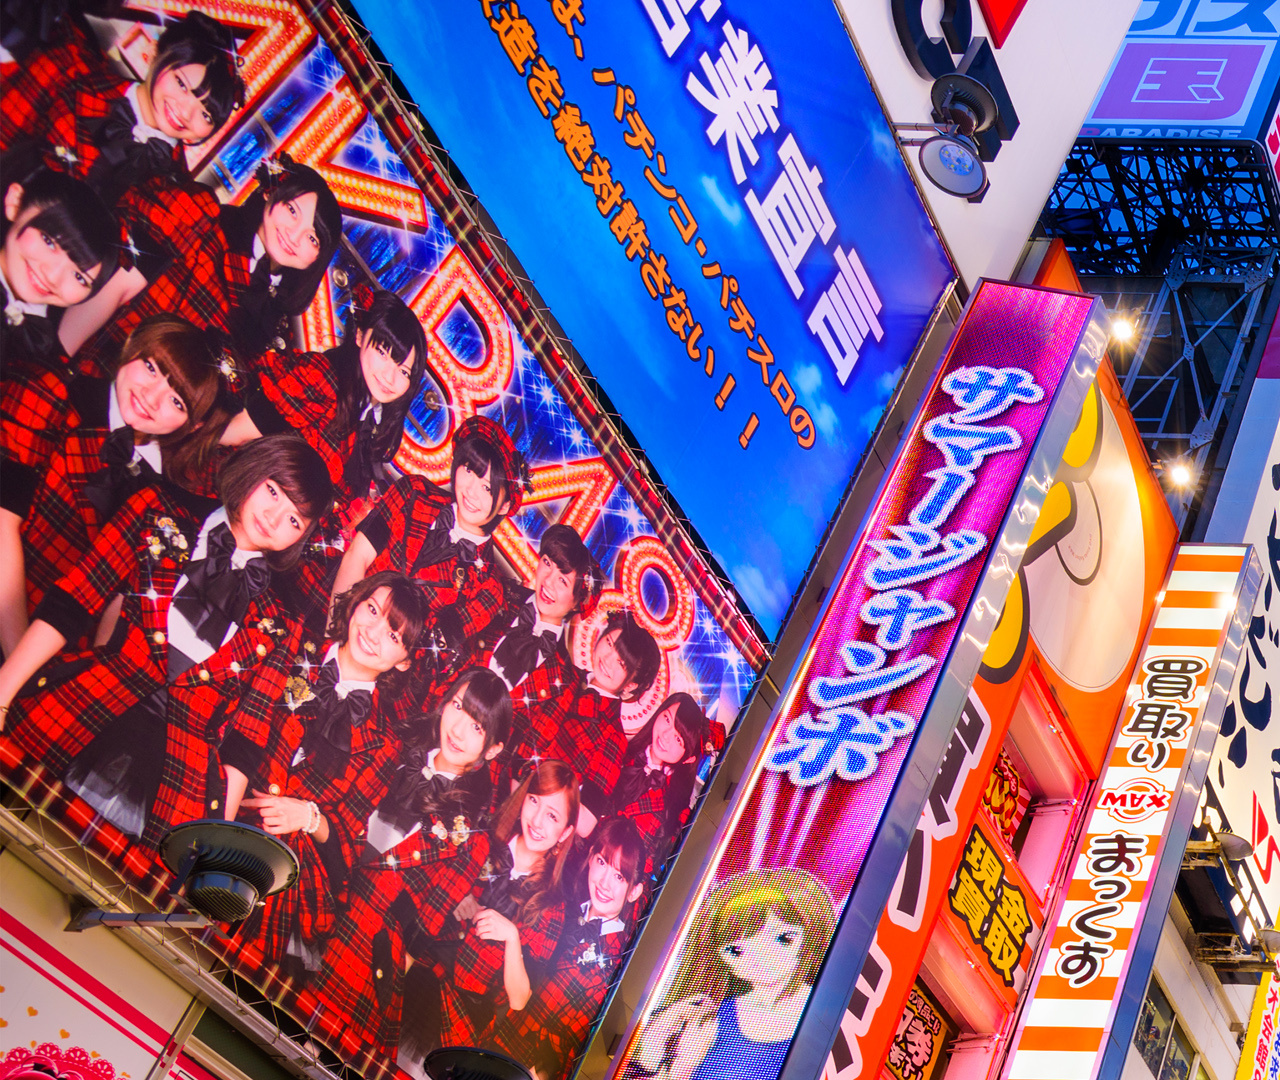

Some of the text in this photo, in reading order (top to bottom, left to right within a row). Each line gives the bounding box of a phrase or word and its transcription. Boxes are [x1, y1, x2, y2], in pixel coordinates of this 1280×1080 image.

[763, 364, 1045, 787] サマージャンボ
[1060, 658, 1205, 986] 買取り まっくす
